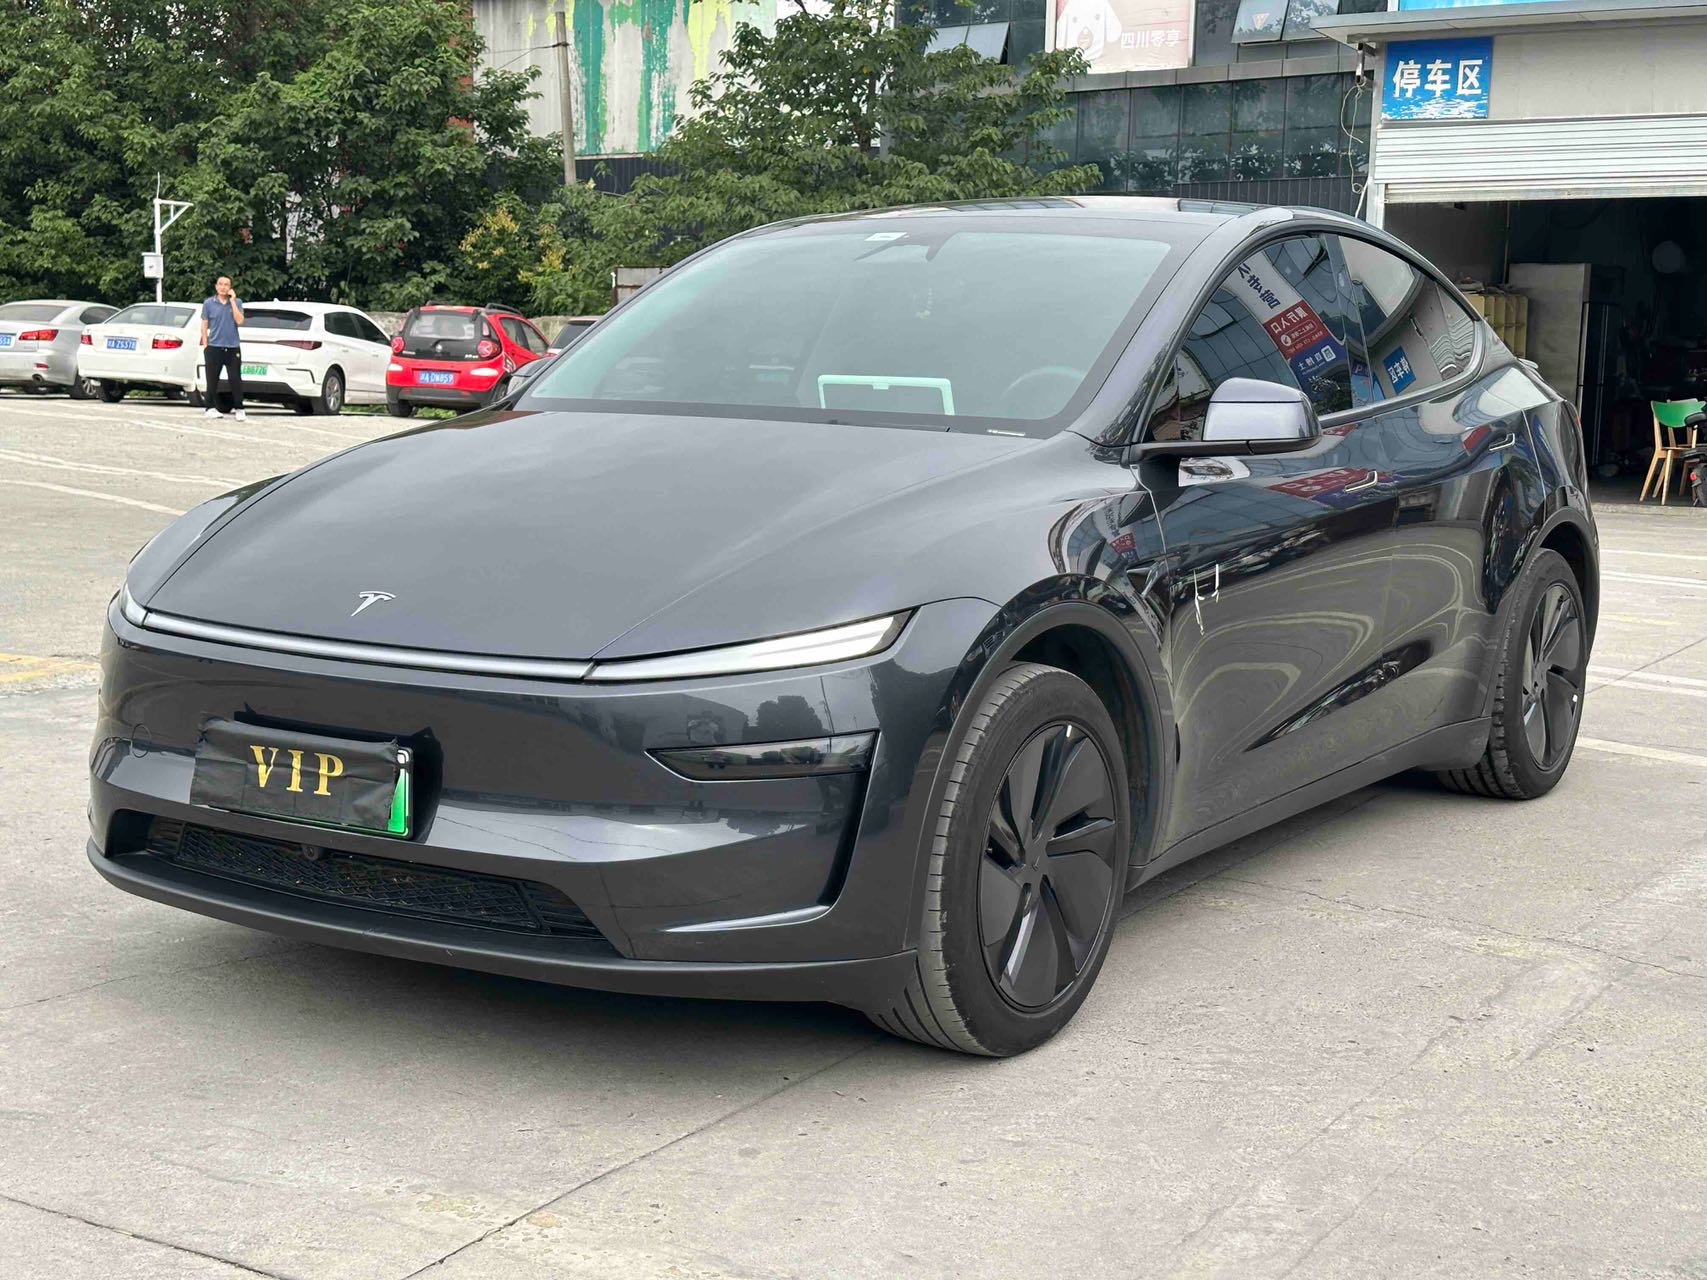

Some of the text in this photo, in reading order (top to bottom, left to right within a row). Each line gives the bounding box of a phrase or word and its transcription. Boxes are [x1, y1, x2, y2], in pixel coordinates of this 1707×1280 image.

[1393, 59, 1483, 97] 停车区
[249, 745, 345, 797] VIP
